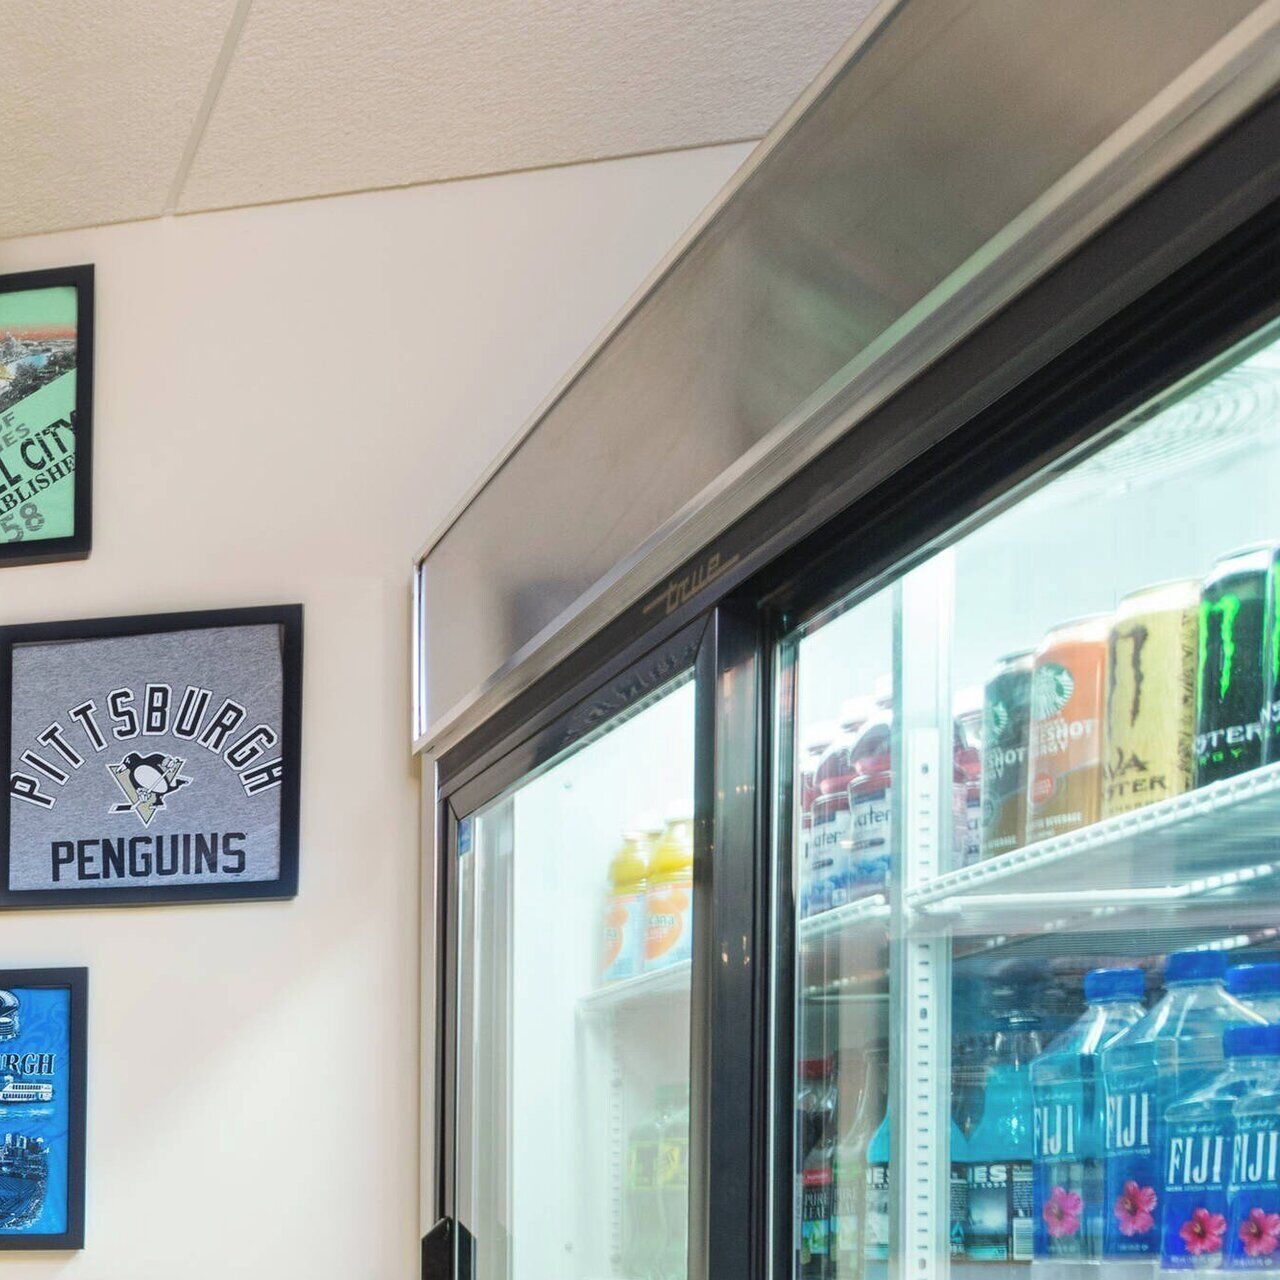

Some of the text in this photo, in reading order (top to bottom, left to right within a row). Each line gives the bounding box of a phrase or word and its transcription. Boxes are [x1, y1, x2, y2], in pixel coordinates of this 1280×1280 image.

[10, 682, 283, 811] PITTSBURGH
[51, 832, 248, 882] PENGUINS
[1168, 1135, 1224, 1185] FIJI
